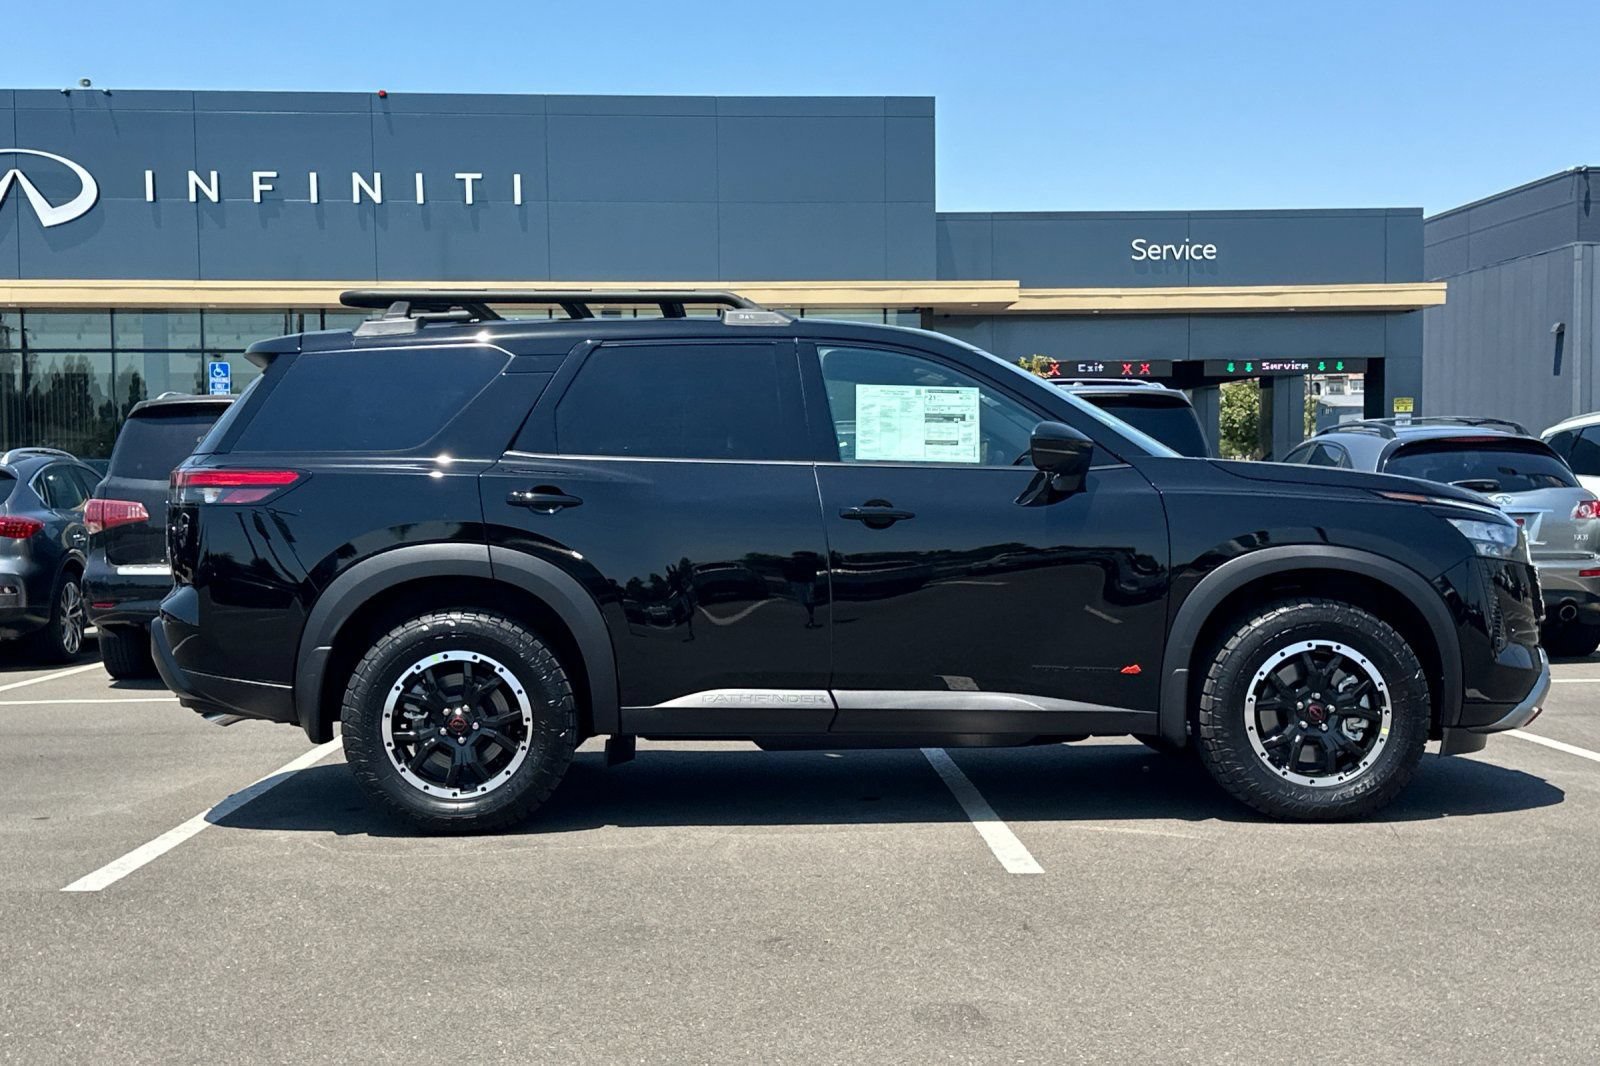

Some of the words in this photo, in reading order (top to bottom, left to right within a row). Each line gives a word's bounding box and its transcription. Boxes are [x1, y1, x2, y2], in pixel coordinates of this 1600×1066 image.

[144, 169, 522, 205] INFINITI
[1131, 238, 1217, 260] Service
[1077, 362, 1104, 373] Exit
[1261, 360, 1309, 371] Service
[701, 694, 827, 704] PATHFINDER
